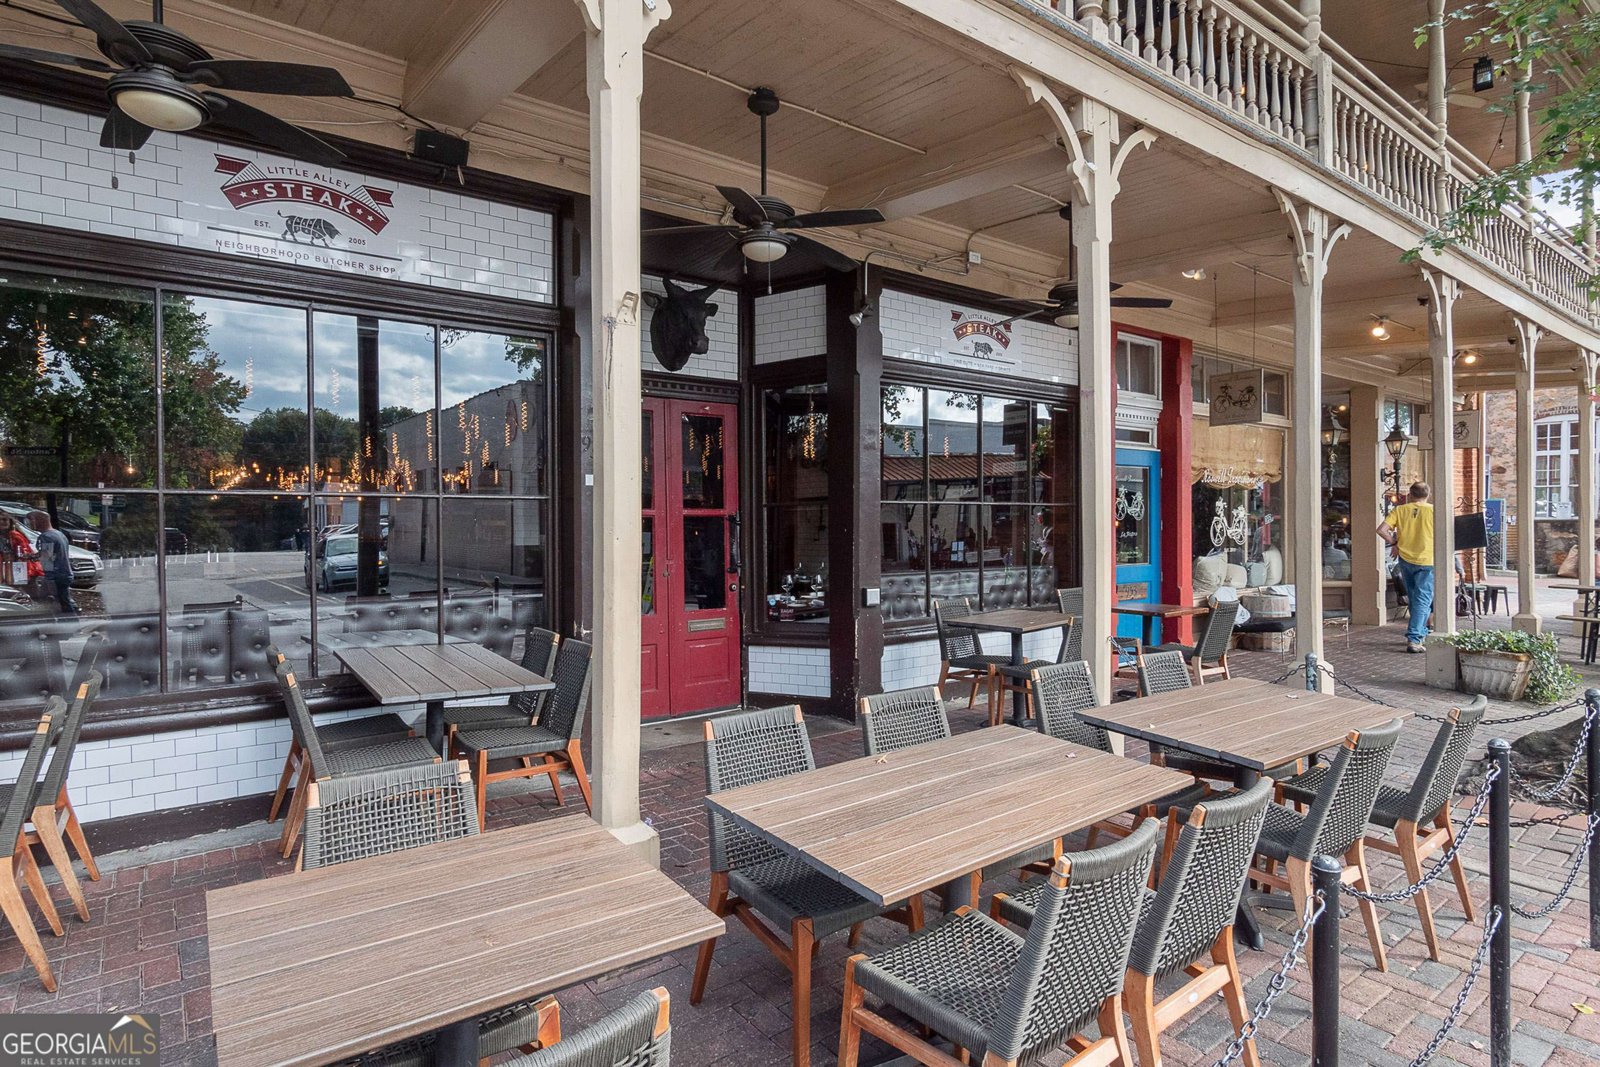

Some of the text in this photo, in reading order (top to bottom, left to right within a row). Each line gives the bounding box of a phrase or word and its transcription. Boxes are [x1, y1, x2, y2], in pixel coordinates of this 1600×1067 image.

[267, 166, 350, 190] LITTLE ALLEY
[264, 183, 352, 213] STEAK
[254, 219, 366, 246] EST. 2005
[215, 239, 396, 274] NEIGHBORHOOD BUTCHER SHOP
[967, 323, 997, 339] STEAK
